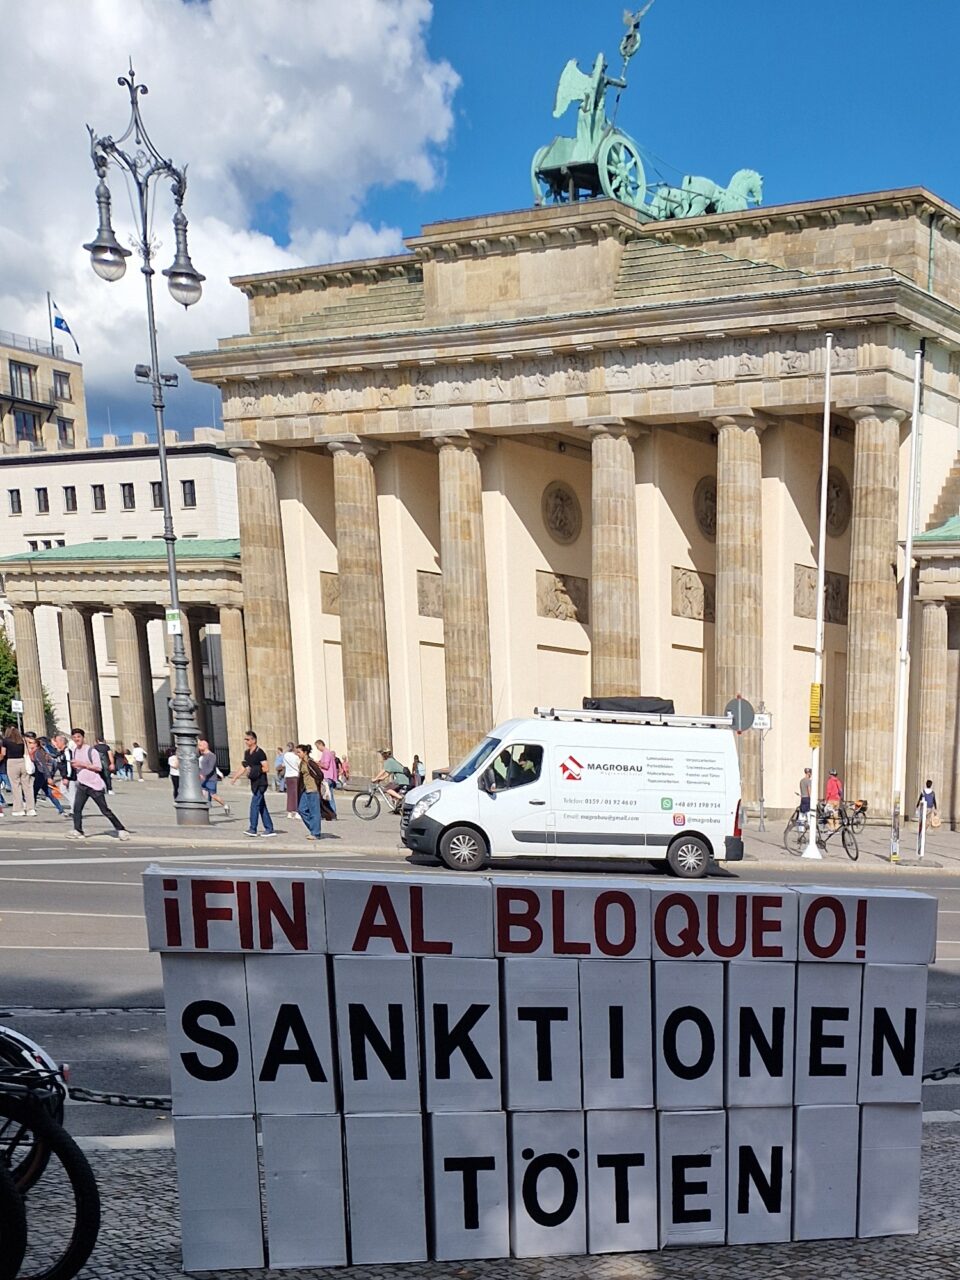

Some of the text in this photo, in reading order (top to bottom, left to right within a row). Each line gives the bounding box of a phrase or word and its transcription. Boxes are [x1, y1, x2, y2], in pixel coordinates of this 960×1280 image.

[587, 763, 643, 773] MAGROBAU
[353, 885, 453, 956] AL
[496, 886, 868, 960] BLOQUEO!
[179, 999, 918, 1084] SANKTIONEN
[443, 1145, 784, 1231] TÖTEN
